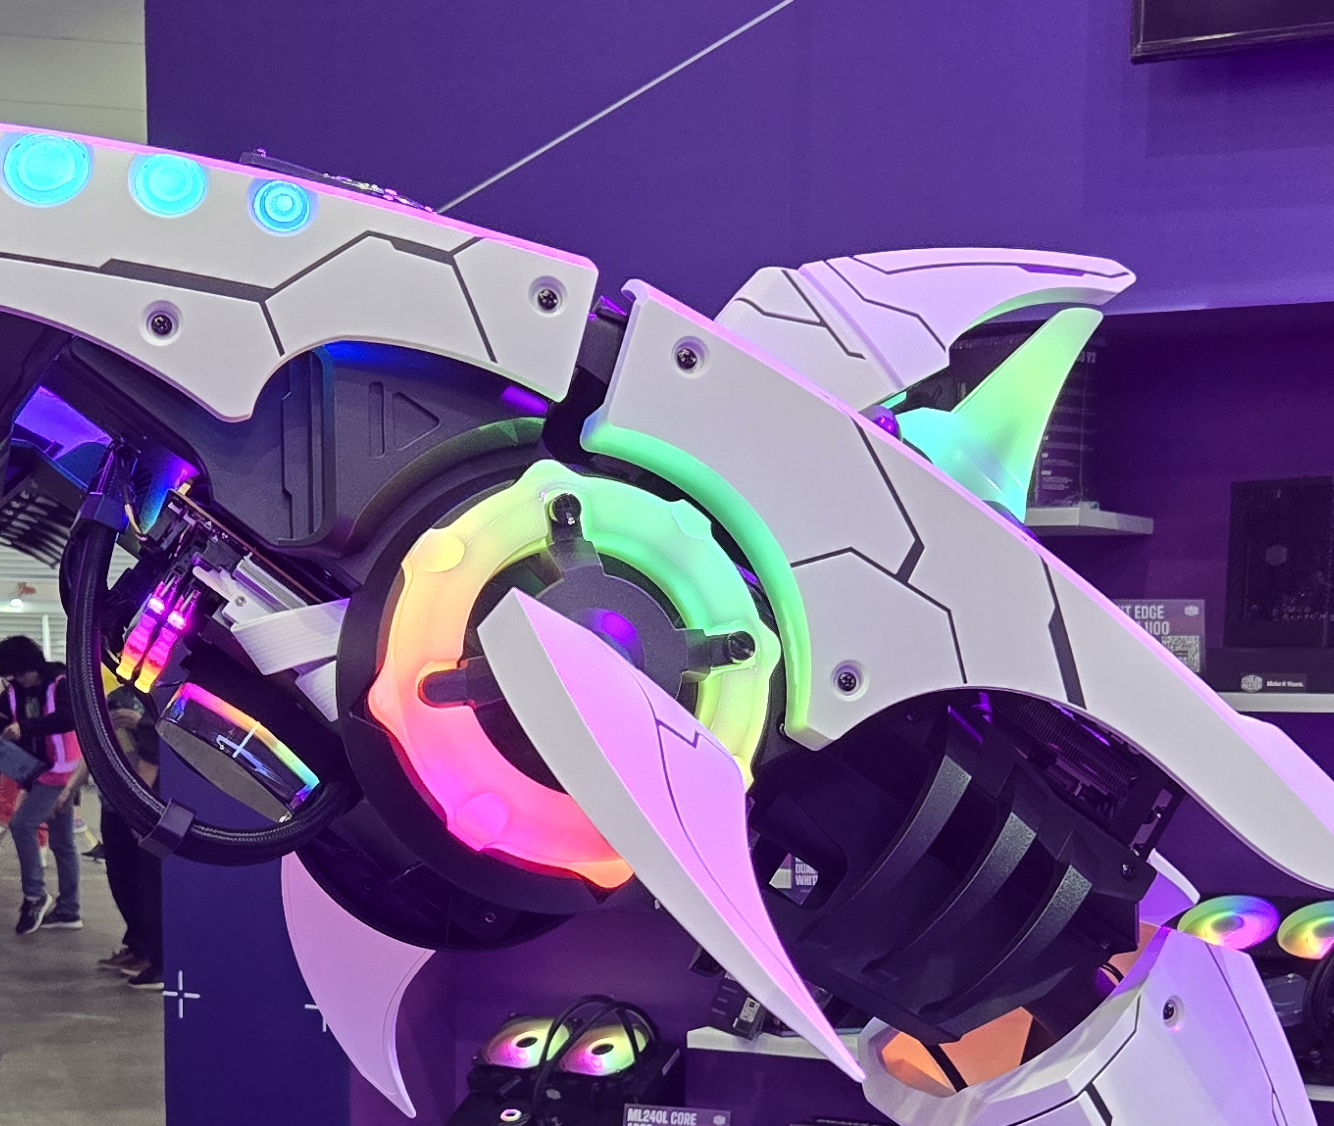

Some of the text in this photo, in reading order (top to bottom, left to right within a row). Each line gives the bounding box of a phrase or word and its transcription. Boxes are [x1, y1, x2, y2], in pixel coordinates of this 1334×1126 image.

[1134, 605, 1164, 620] EDGE
[1144, 621, 1170, 636] 1100
[627, 1108, 697, 1126] ML240L CORE
